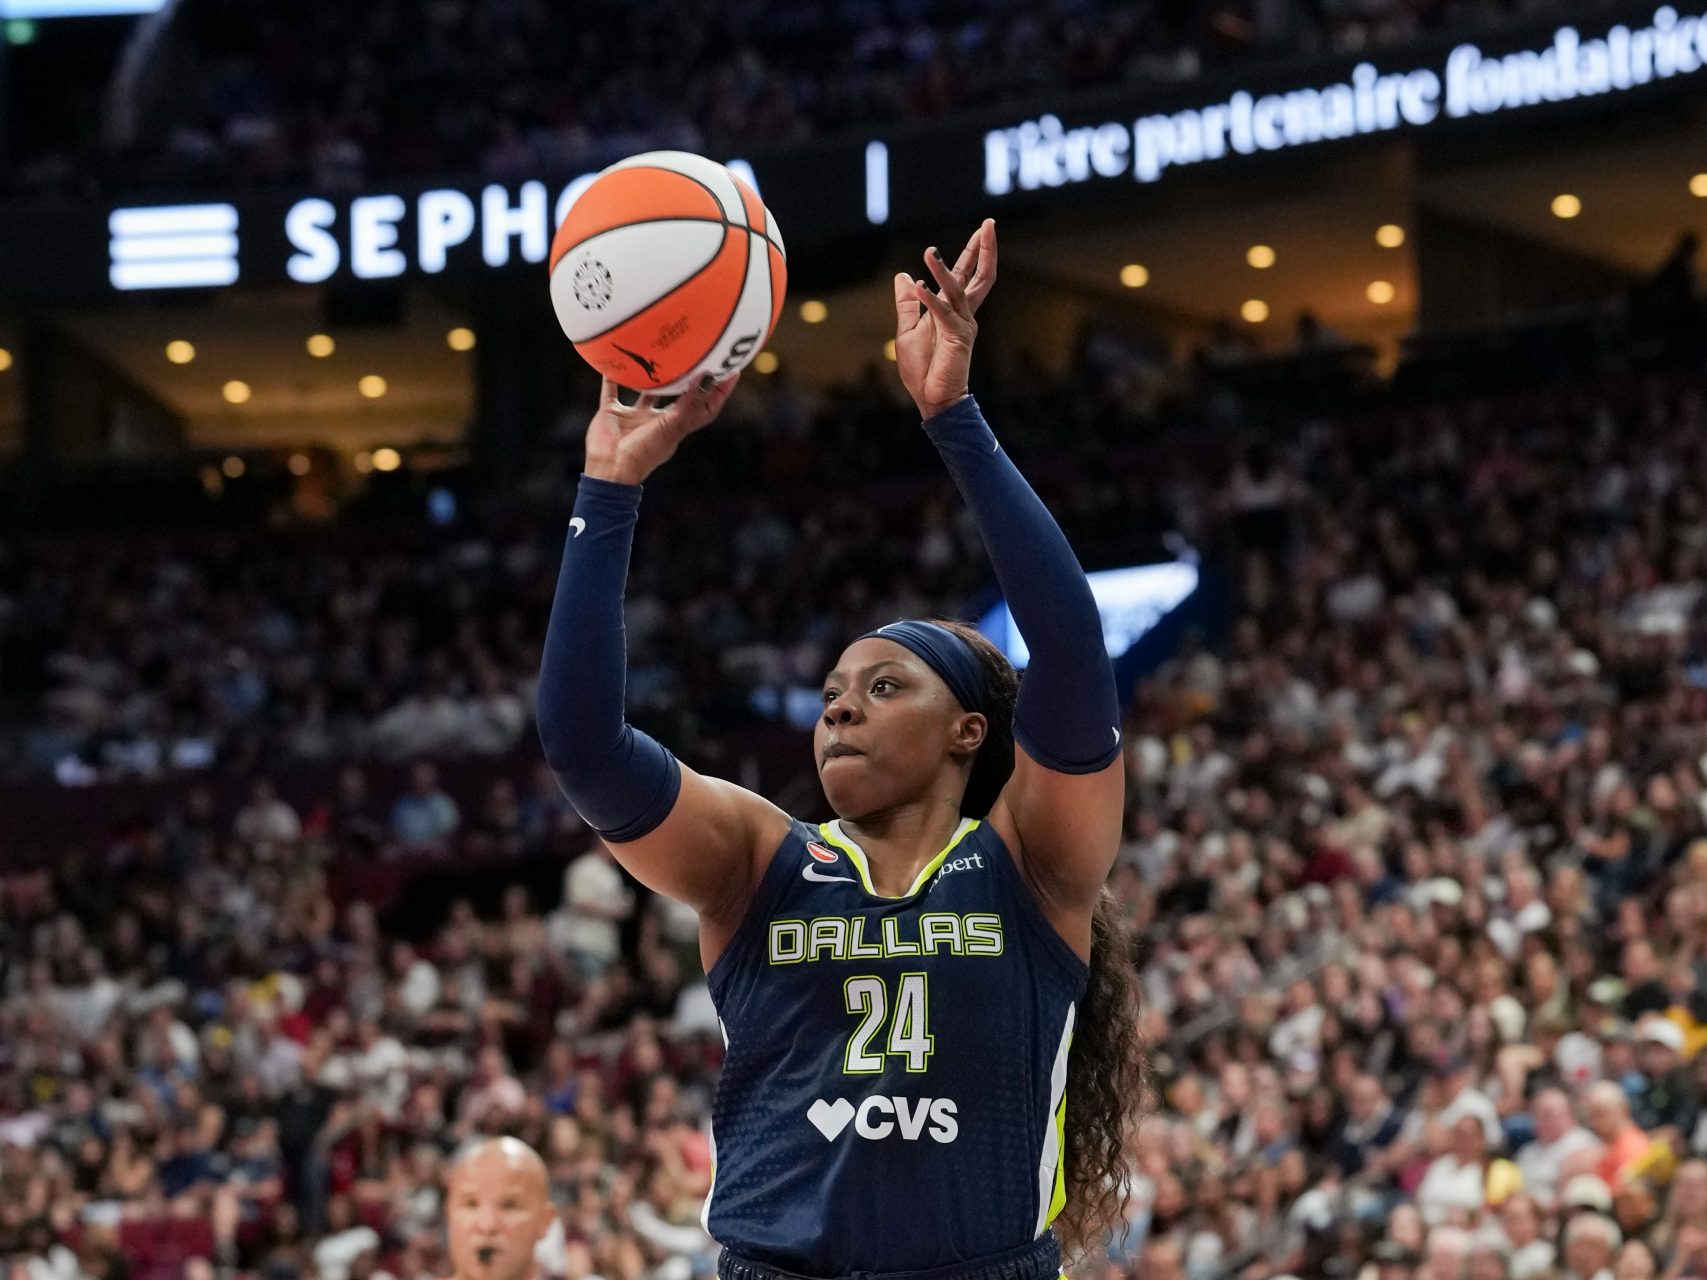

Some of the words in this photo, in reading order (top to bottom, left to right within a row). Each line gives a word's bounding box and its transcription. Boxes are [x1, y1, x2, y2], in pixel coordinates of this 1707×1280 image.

[1134, 62, 1440, 183] partenaire
[1446, 5, 1707, 118] fondatric
[769, 913, 1004, 966] DALLAS
[843, 972, 934, 1075] 24
[855, 1094, 959, 1144] CVS
